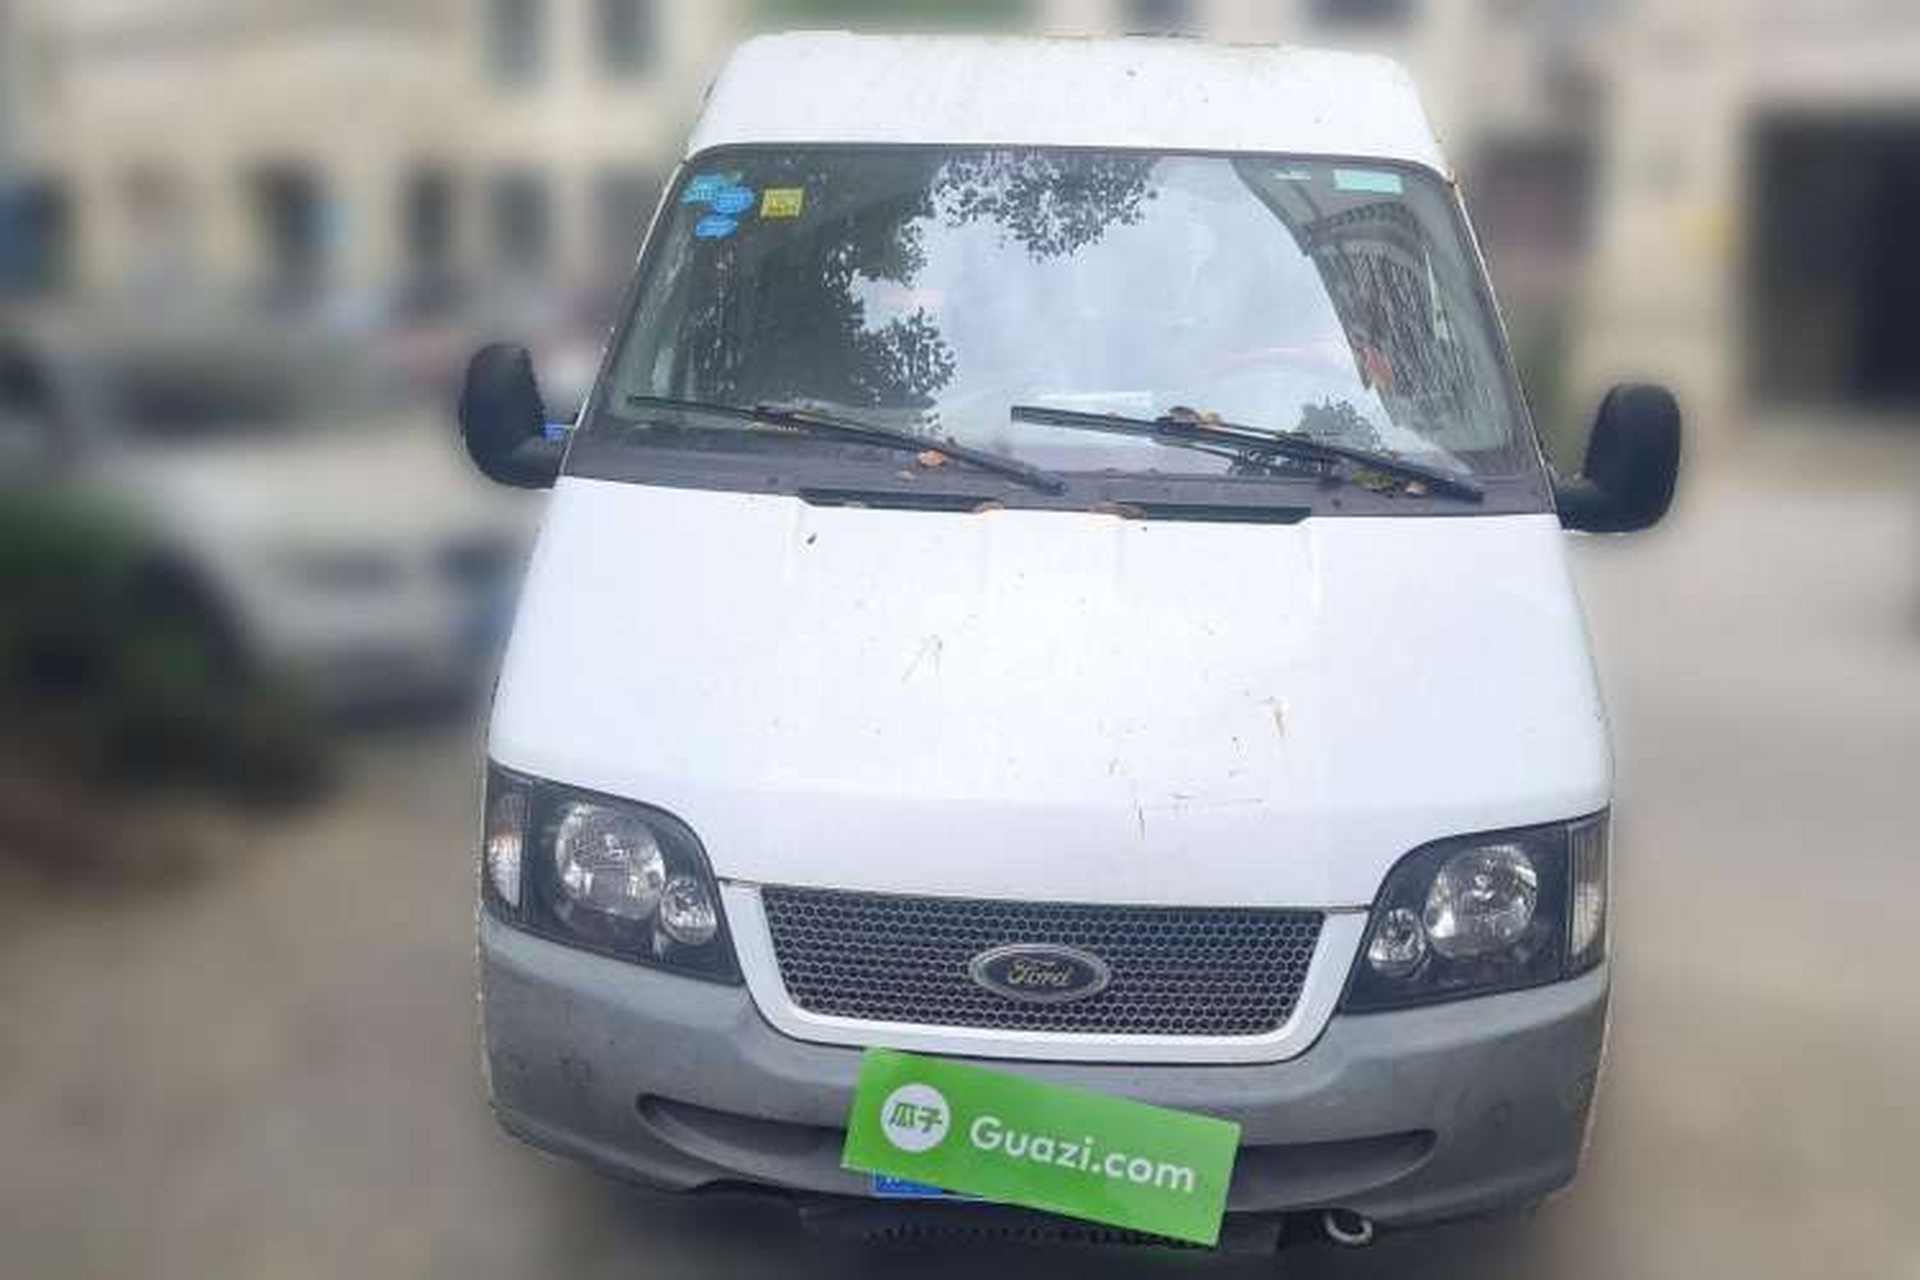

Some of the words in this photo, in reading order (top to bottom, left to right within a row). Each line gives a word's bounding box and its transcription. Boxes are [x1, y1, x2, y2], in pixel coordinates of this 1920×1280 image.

[1008, 959, 1073, 987] Ford
[889, 1102, 943, 1133] 瓜子
[970, 1116, 1195, 1192] Guazi.com
